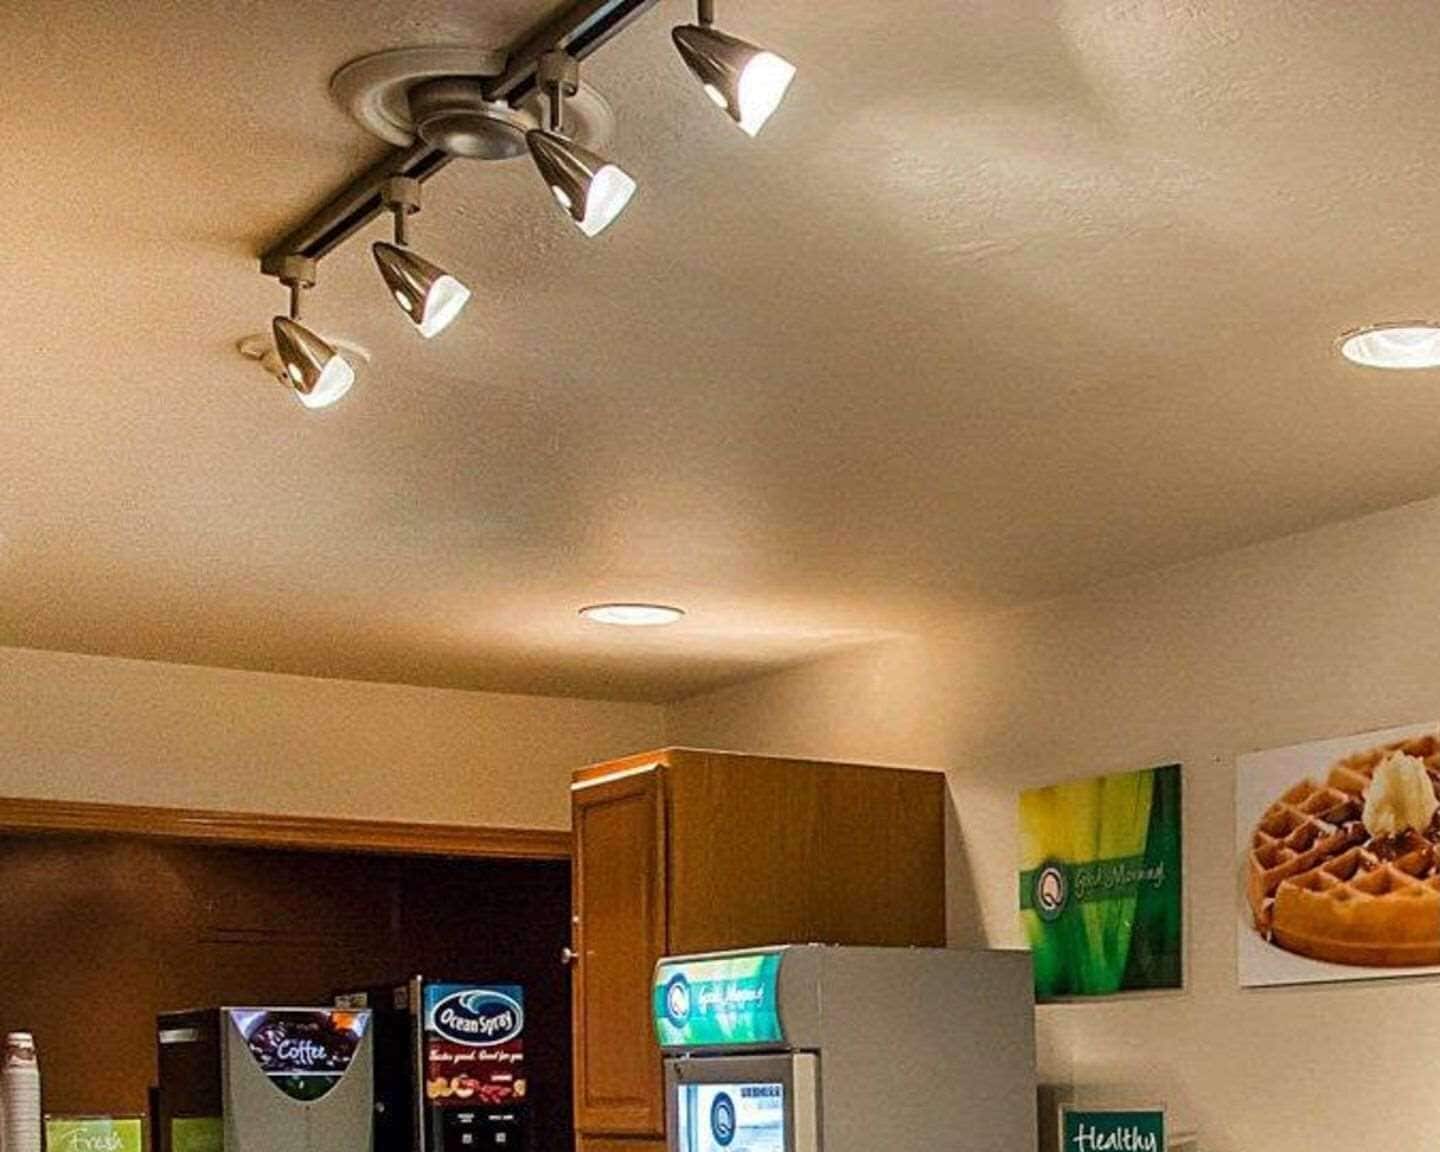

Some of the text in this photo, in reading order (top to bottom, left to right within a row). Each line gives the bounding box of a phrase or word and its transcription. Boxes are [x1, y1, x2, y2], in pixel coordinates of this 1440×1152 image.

[441, 1008, 513, 1036] Ocean Spray
[277, 1039, 327, 1065] Coffee
